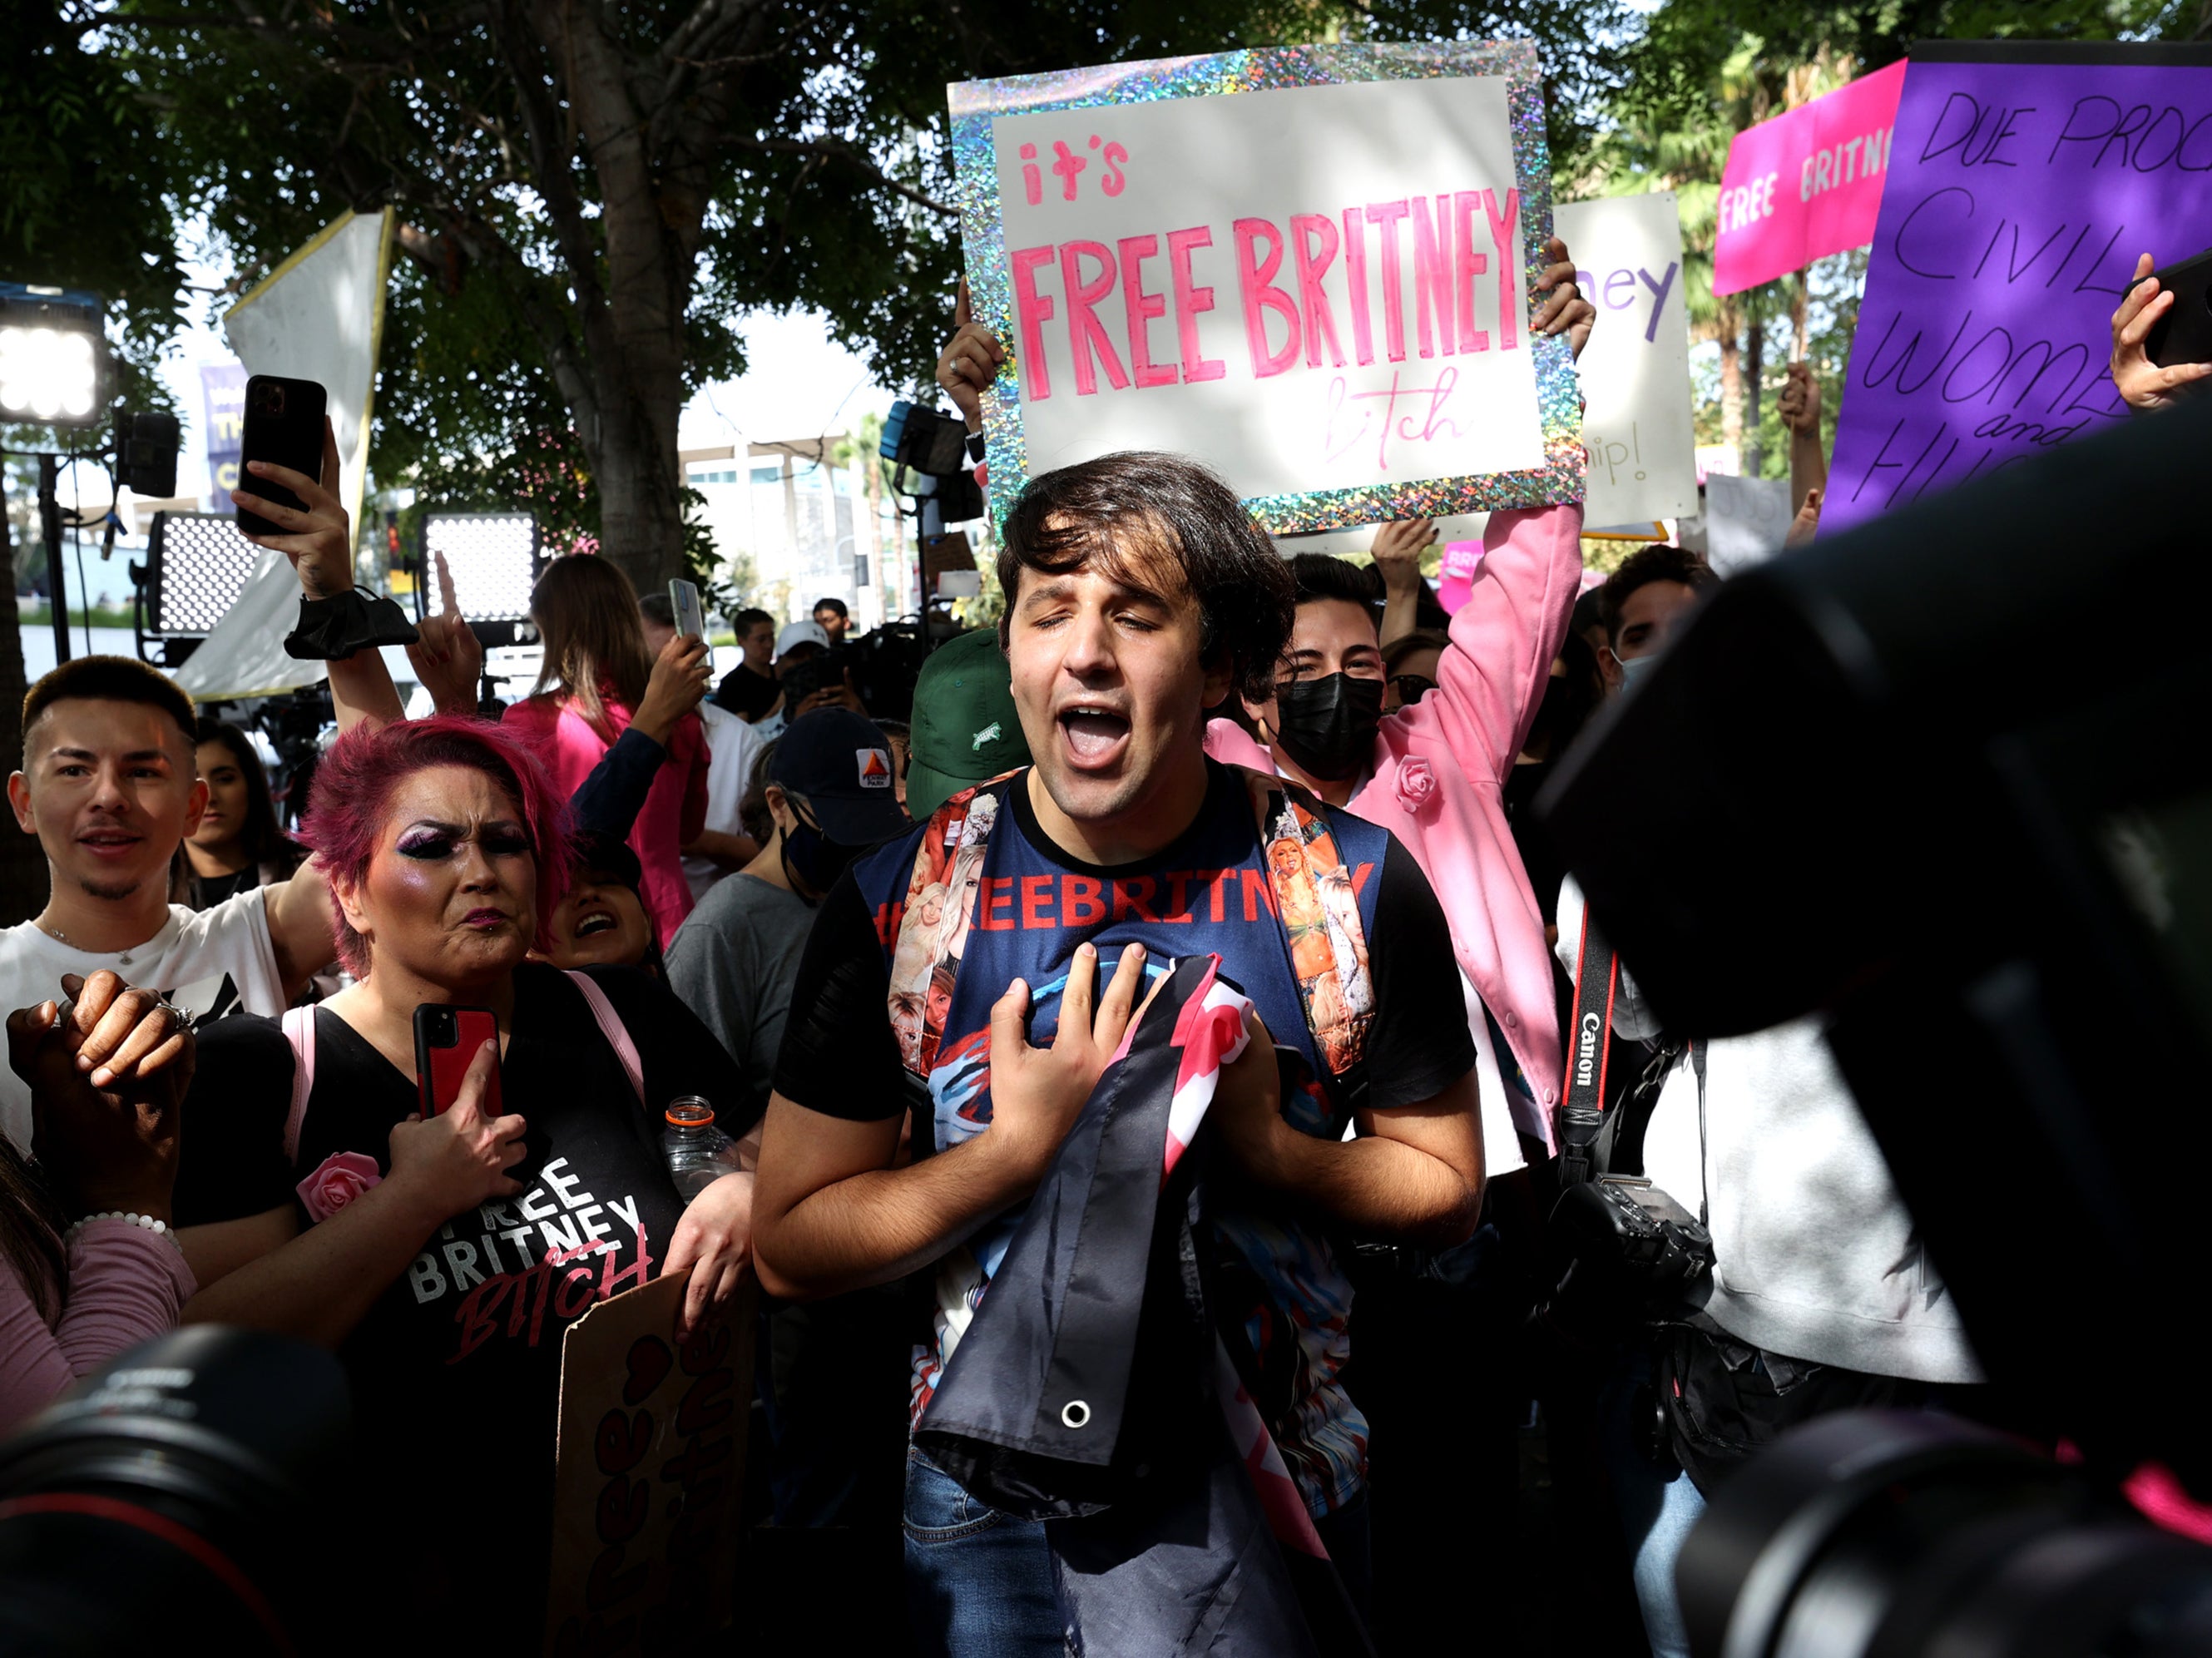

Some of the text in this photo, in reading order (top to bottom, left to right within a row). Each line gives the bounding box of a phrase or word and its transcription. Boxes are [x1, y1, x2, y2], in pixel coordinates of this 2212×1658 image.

[1918, 92, 2036, 166] DUE
[1020, 133, 1129, 206] it's
[1720, 171, 1778, 235] FREE
[1896, 187, 2124, 294] CIVIL
[1010, 186, 1519, 403] FREE BRITNEY
[1325, 366, 1474, 470] bitch
[1974, 414, 2091, 446] and
[1576, 1012, 1601, 1086] Canon
[439, 1157, 595, 1240] REE
[407, 1195, 648, 1304] BRITNEY
